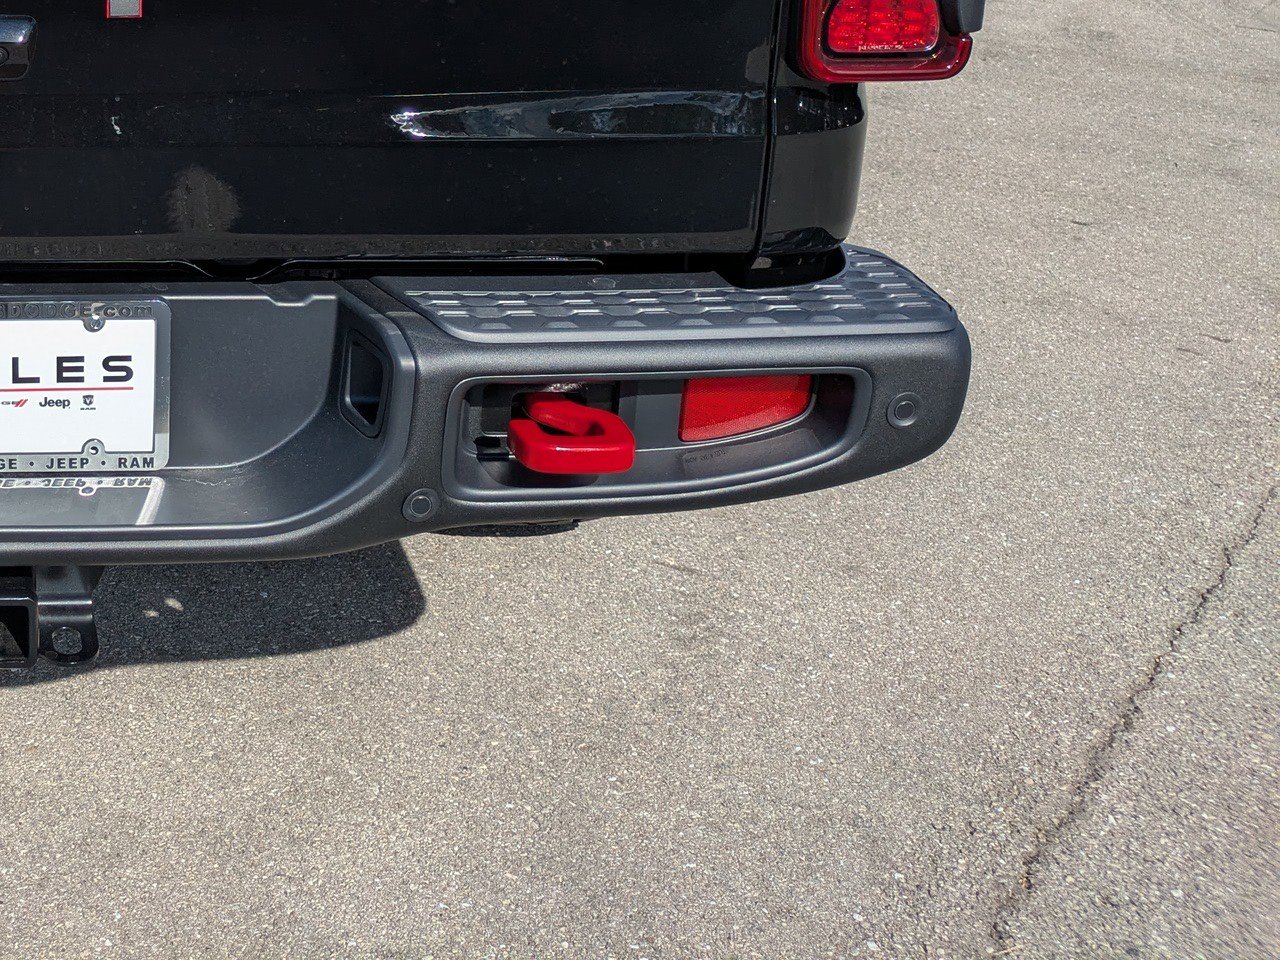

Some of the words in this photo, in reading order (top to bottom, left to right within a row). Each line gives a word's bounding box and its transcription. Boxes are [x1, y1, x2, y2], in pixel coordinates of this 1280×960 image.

[39, 396, 71, 409] Jeep
[45, 457, 89, 470] JEEP
[117, 456, 155, 469] RAM
